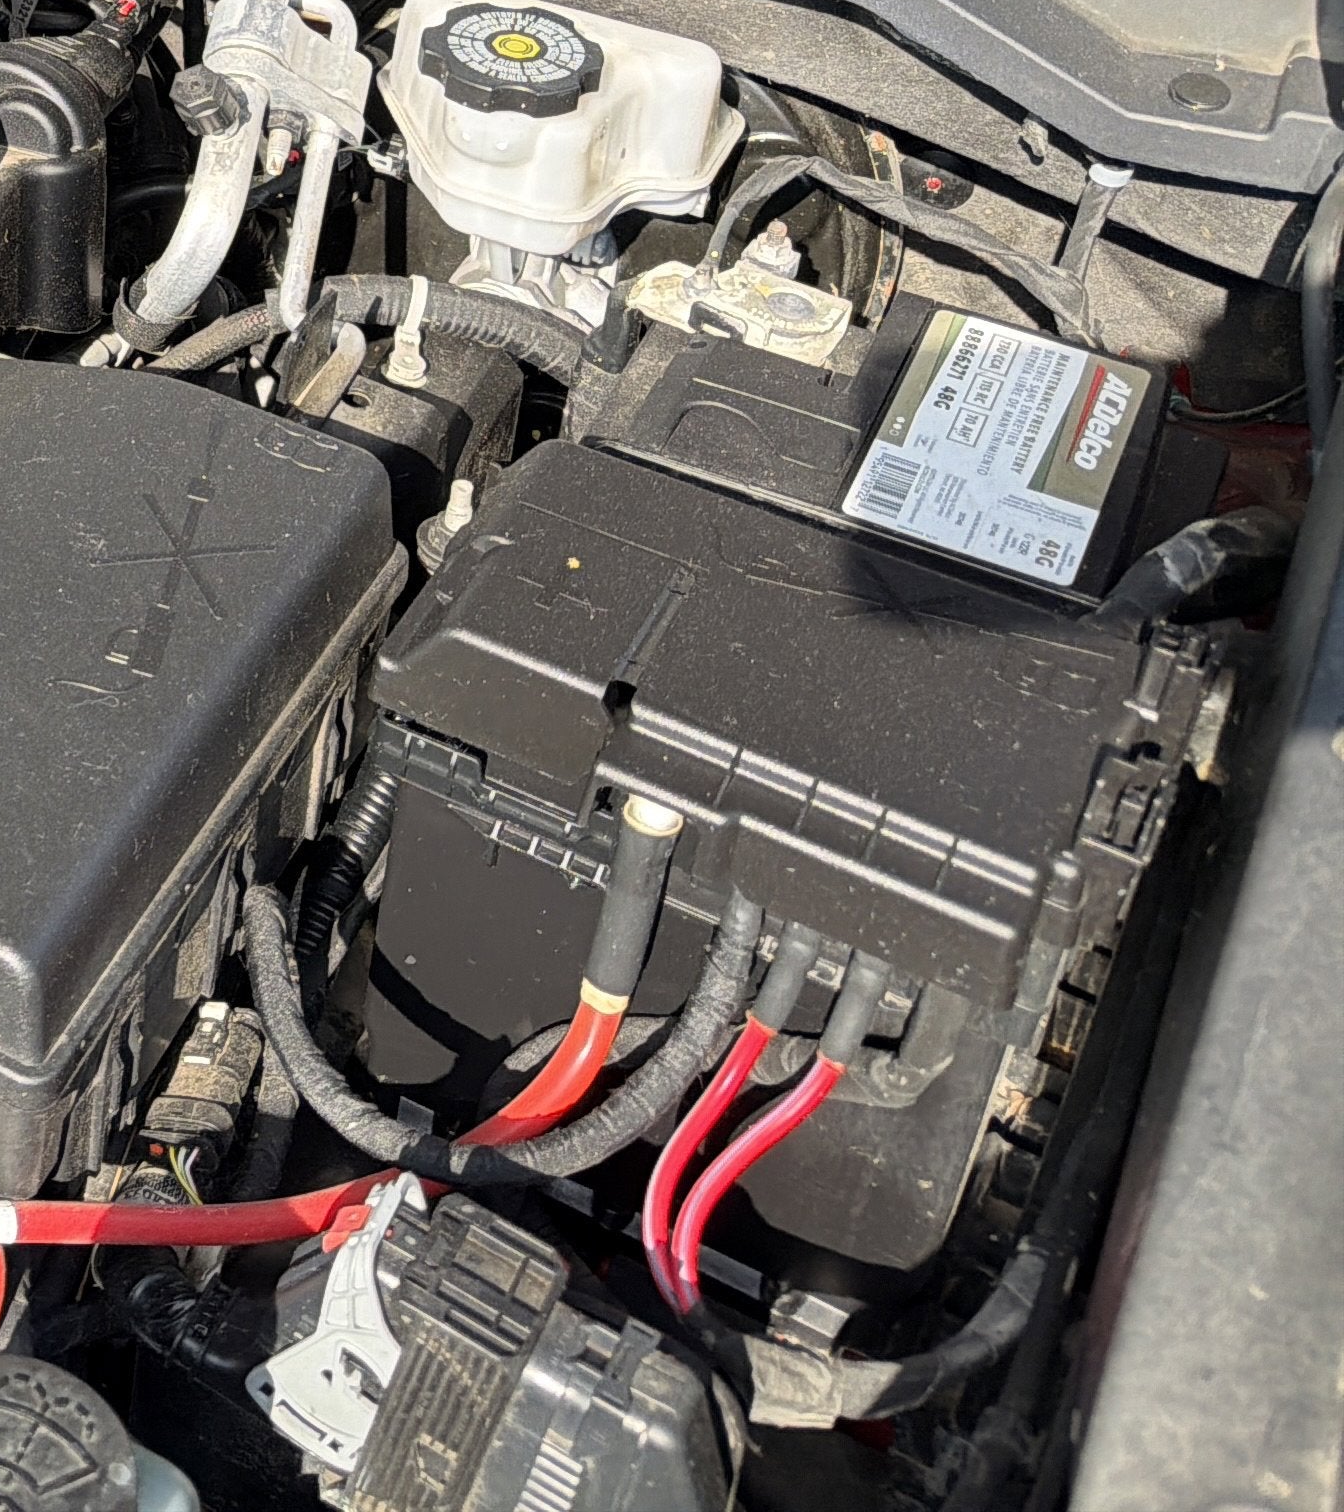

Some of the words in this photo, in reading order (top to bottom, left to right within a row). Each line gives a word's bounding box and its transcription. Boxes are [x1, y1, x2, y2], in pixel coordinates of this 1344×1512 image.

[950, 328, 983, 380] 88866271
[996, 340, 1011, 354] 730
[988, 354, 1004, 369] CCA
[1032, 349, 1055, 382] BATTERIE
[979, 380, 993, 392] 115
[1010, 375, 1027, 396] LIBRE
[1023, 383, 1040, 403] SANS
[1036, 353, 1069, 412] MAINTENANCE
[933, 386, 956, 410] 48G
[973, 391, 988, 404] RC
[1005, 397, 1019, 409] DE
[964, 413, 978, 424] 70
[1005, 404, 1031, 446] ENTRETIEN
[1026, 413, 1044, 434] FREE
[1075, 373, 1131, 468] ACDelco
[977, 410, 1012, 475] MANTENIMIENTO
[1010, 436, 1035, 474] BATTERY
[1034, 539, 1060, 567] 48G
